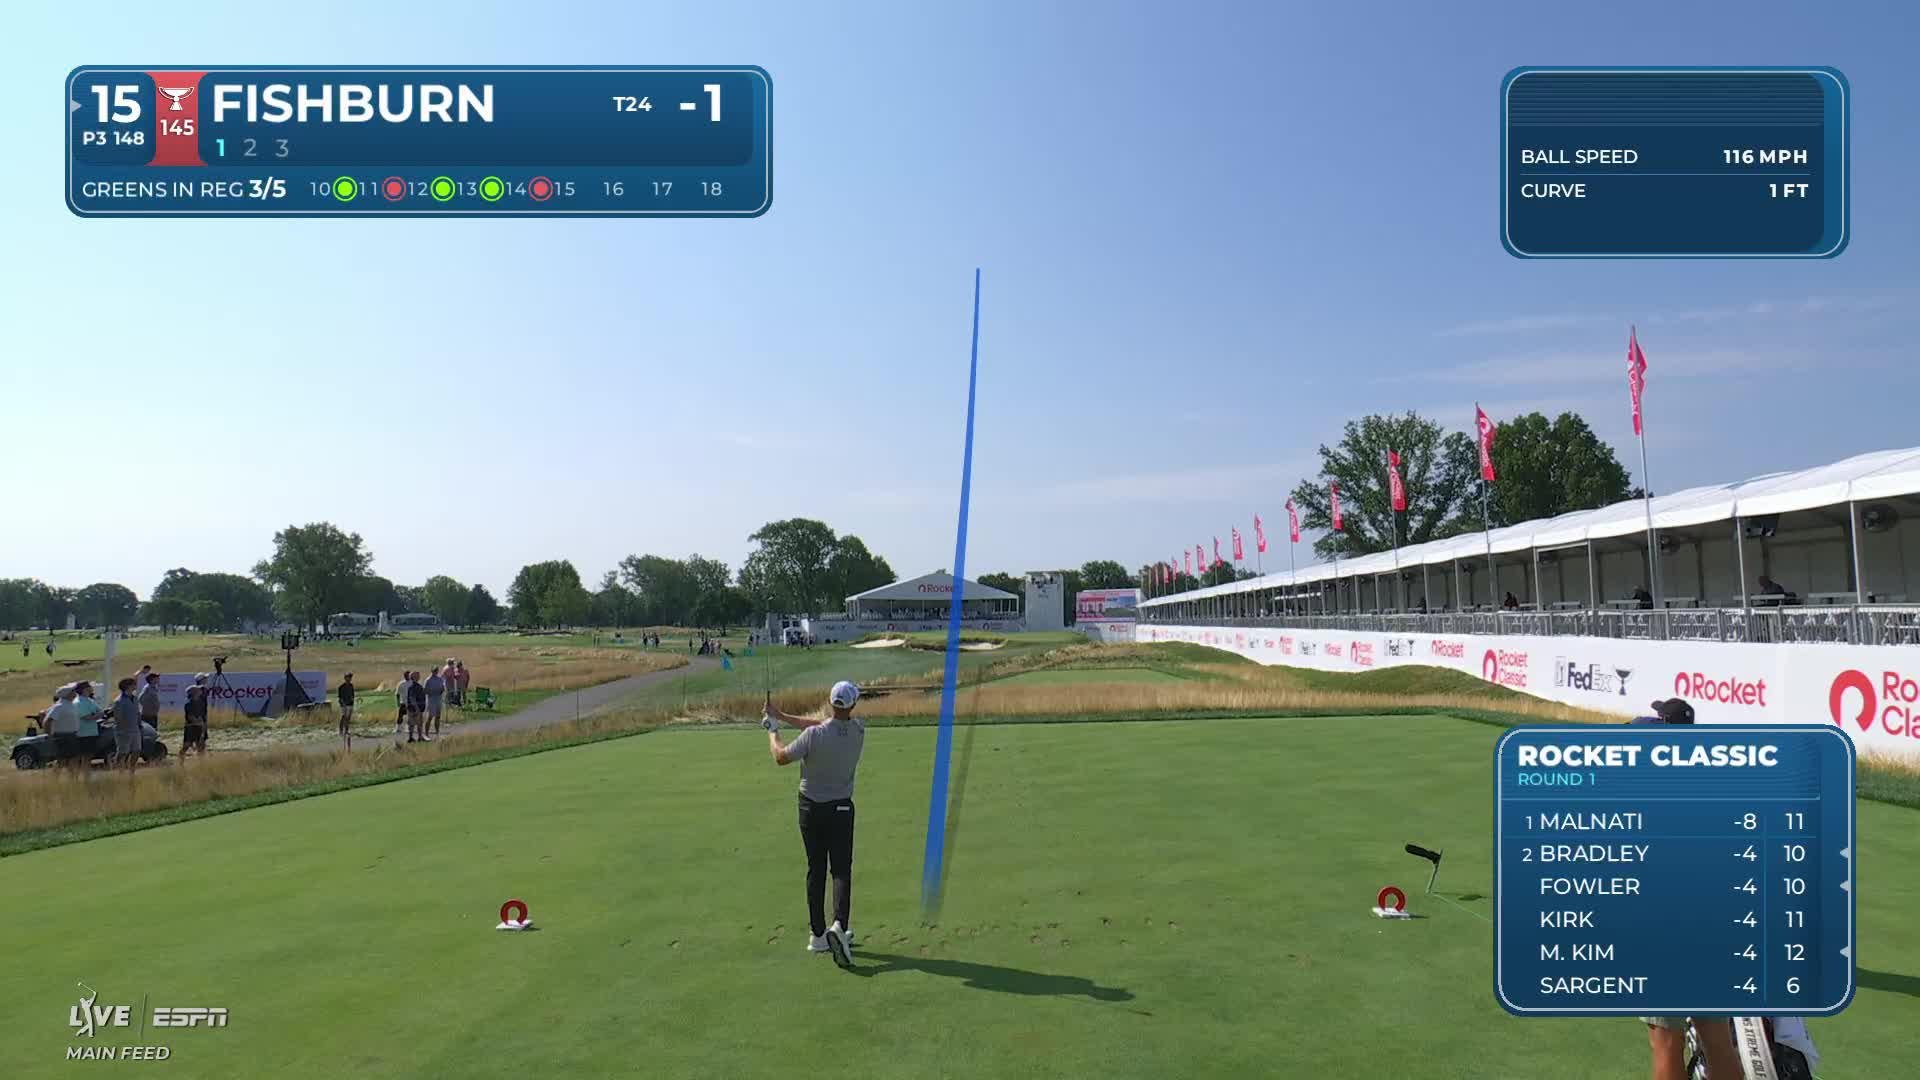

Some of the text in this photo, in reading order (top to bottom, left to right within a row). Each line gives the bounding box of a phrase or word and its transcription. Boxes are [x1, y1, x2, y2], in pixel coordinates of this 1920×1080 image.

[927, 583, 958, 593] Rock
[1499, 649, 1528, 667] Rocket
[1499, 668, 1527, 687] Classic
[1567, 661, 1613, 692] FedEx
[211, 686, 273, 700] Rocket
[1692, 672, 1769, 707] Rocket
[1882, 671, 1920, 703] Ro
[1751, 1059, 1767, 1078] GOLF
